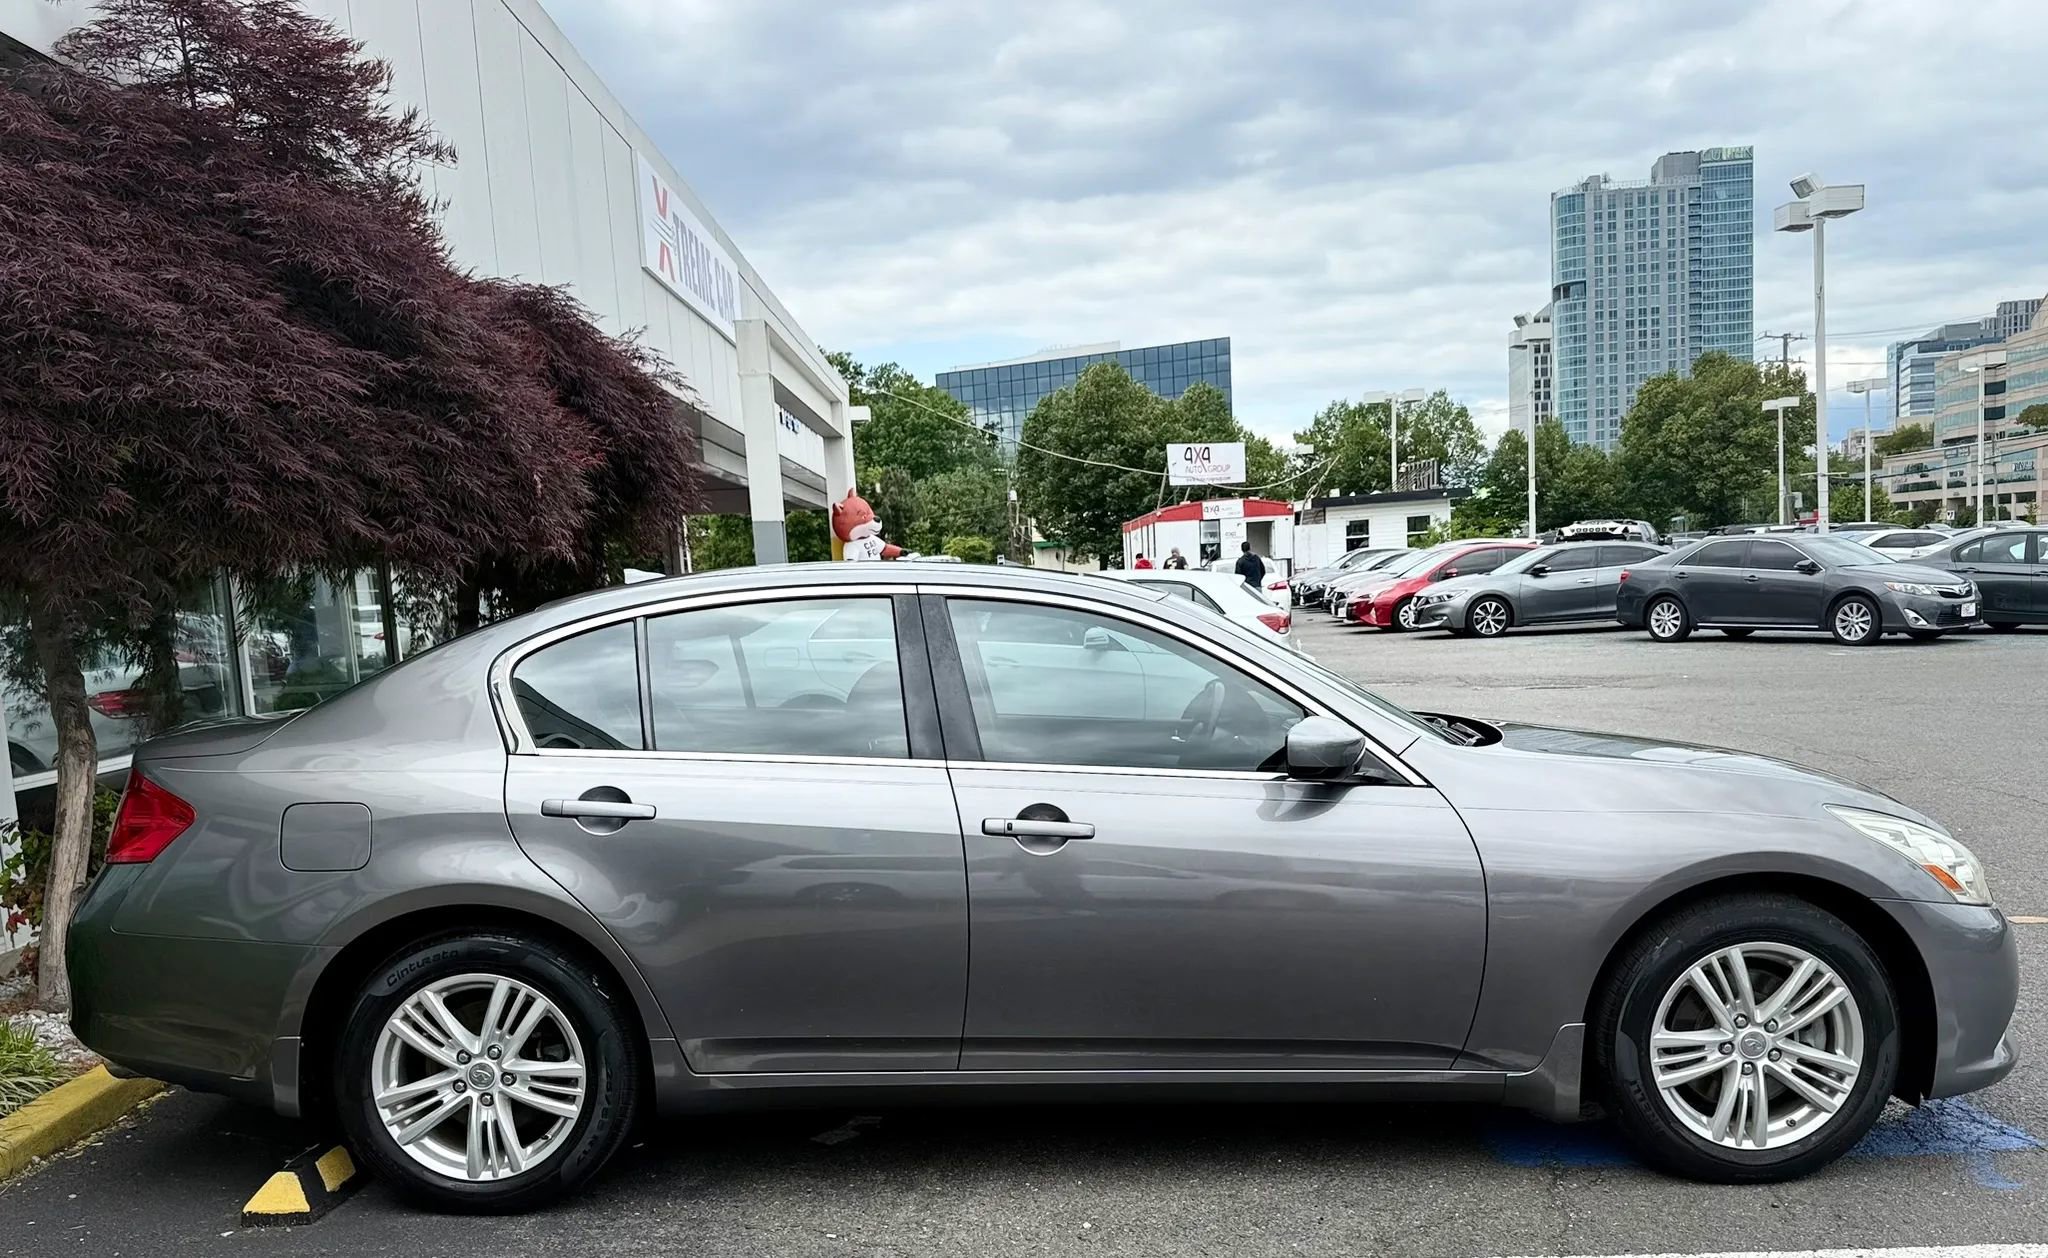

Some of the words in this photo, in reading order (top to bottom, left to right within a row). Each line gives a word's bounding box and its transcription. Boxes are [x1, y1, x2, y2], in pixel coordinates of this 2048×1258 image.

[714, 257, 736, 327] CAR
[1185, 465, 1203, 474] AUTO
[1207, 463, 1231, 473] GROUP
